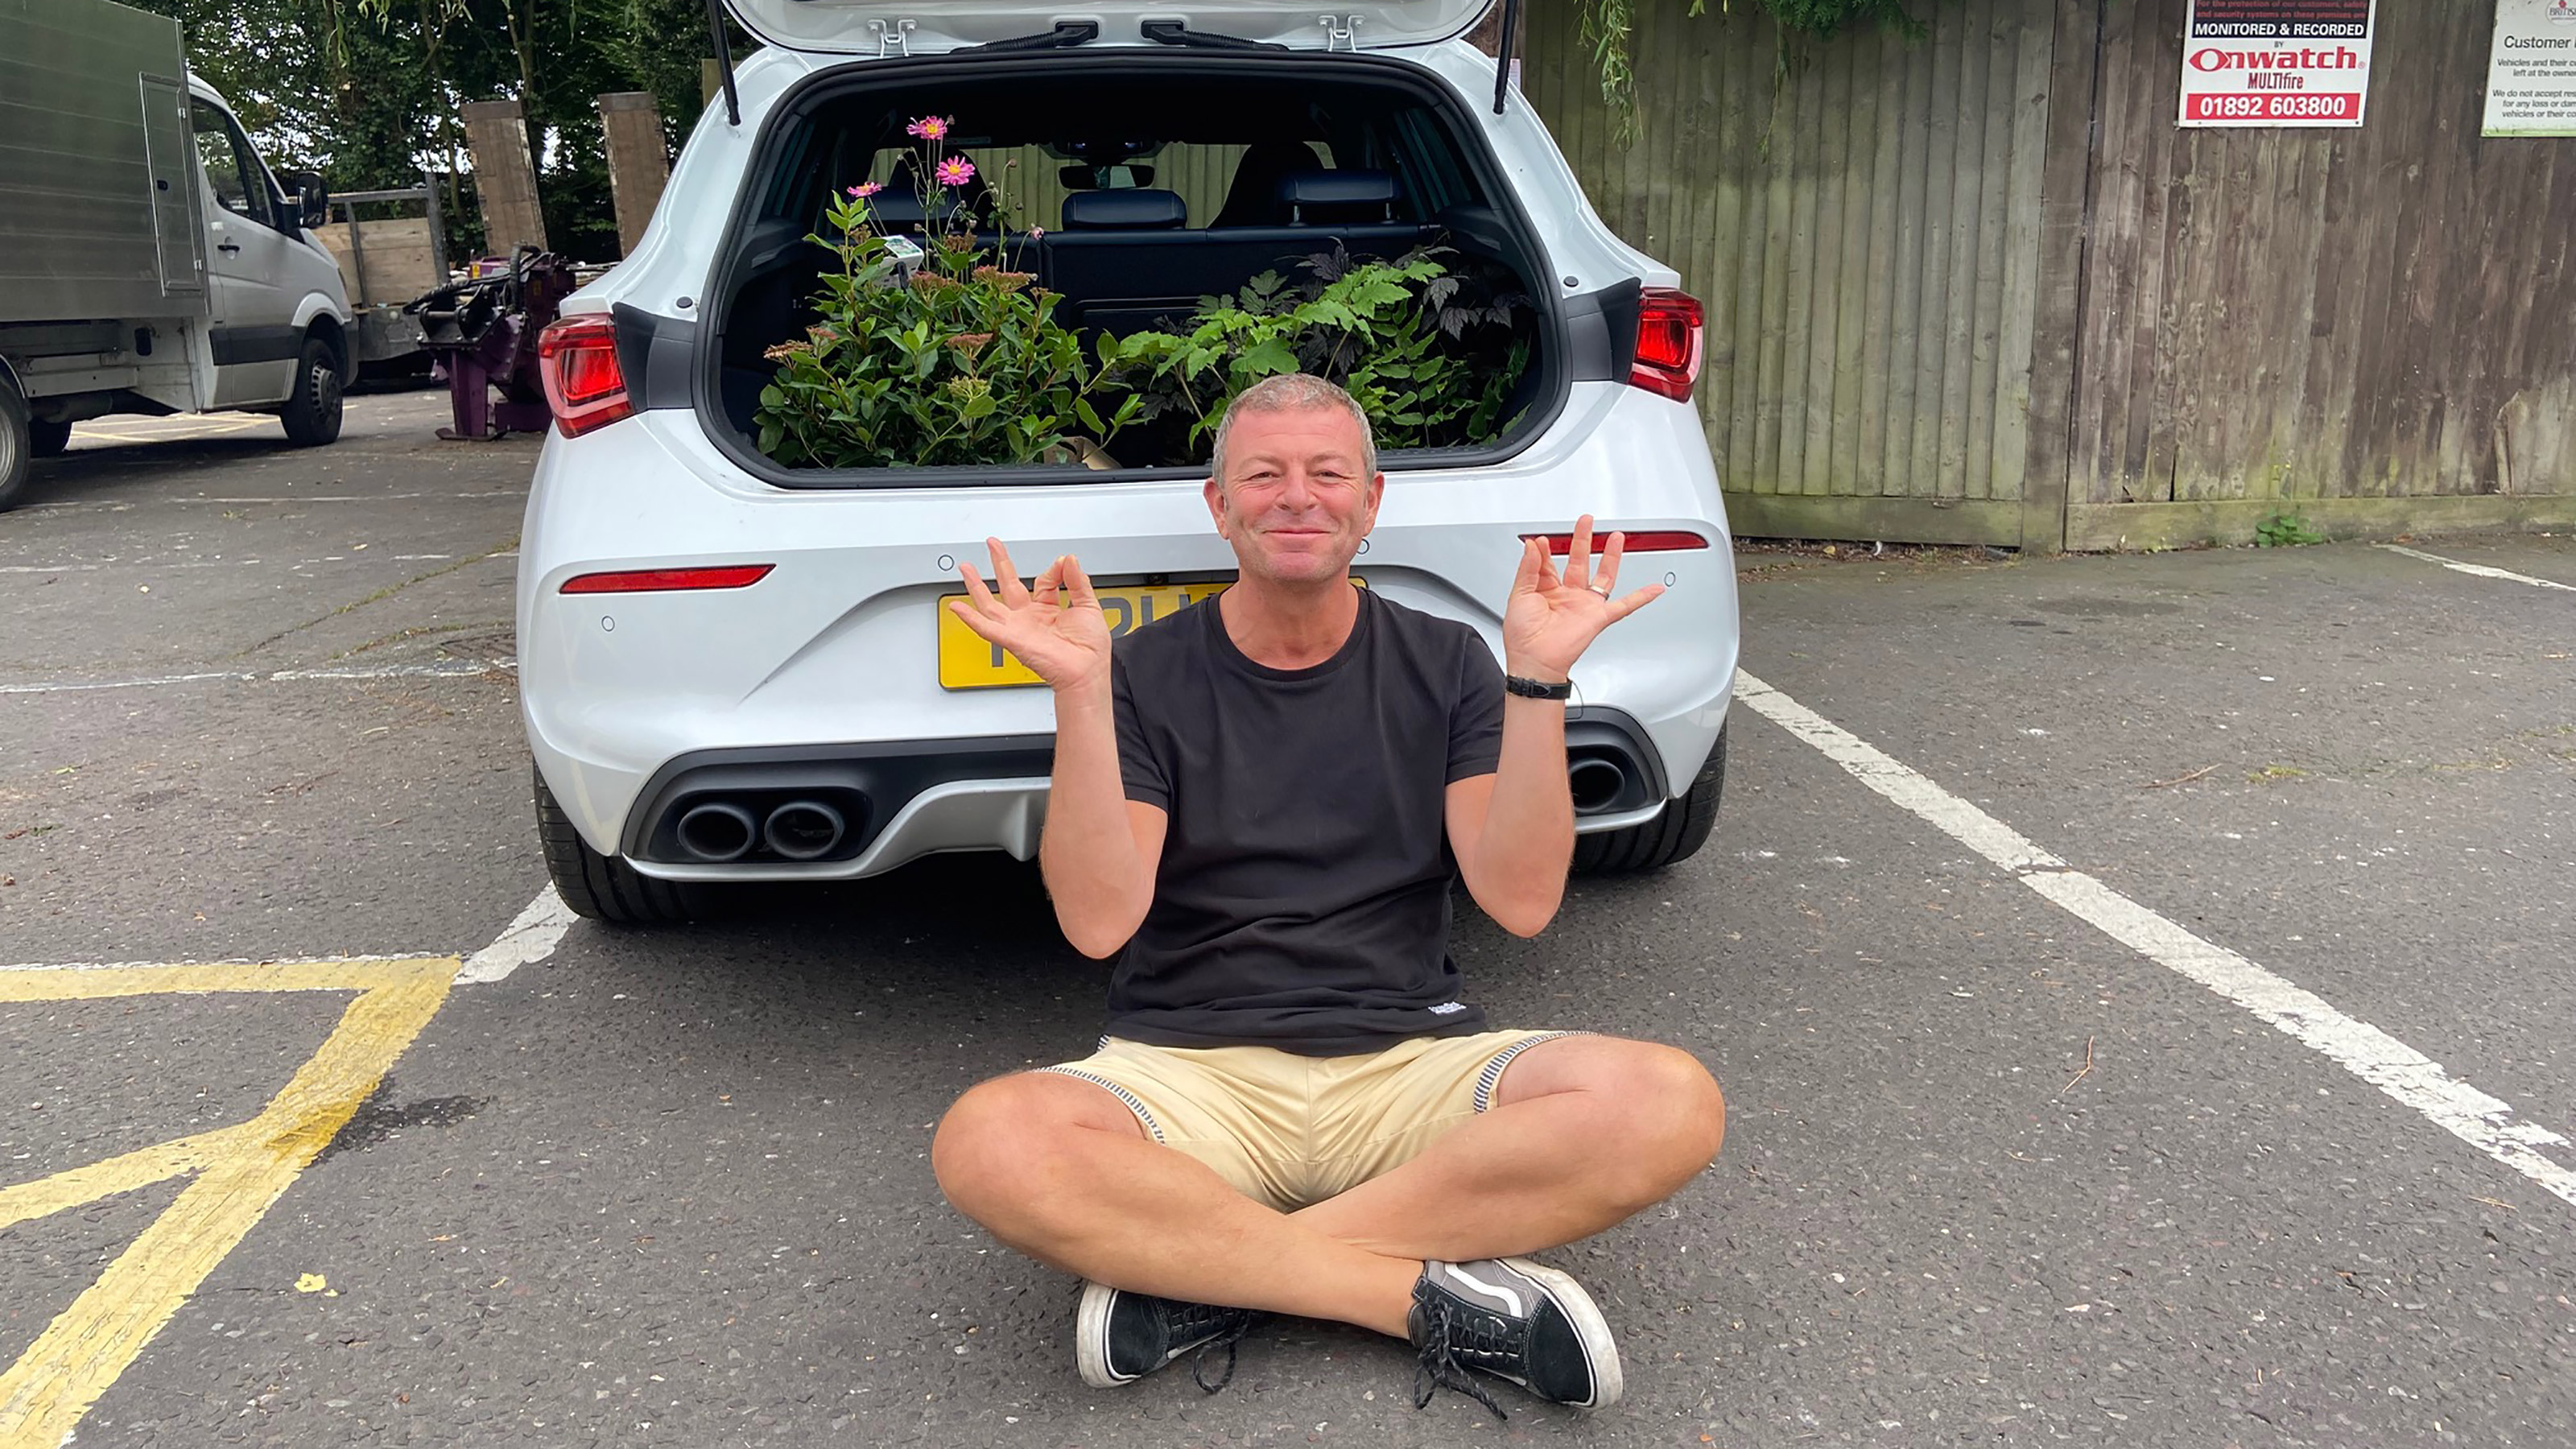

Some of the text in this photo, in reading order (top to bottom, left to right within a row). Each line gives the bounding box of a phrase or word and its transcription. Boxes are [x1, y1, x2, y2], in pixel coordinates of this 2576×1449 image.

[2194, 23, 2364, 36] MONITORED & RECORDED
[2504, 35, 2571, 48] Customer
[2189, 46, 2357, 72] Onwatch
[2497, 59, 2530, 67] Vehicles
[2532, 59, 2549, 67] and
[2549, 59, 2568, 67] their
[2248, 72, 2304, 89] MULTIfire
[2534, 90, 2562, 98] accept
[2199, 96, 2347, 117] 01892 603800
[2516, 101, 2530, 109] any
[2502, 109, 2534, 118] vehicles
